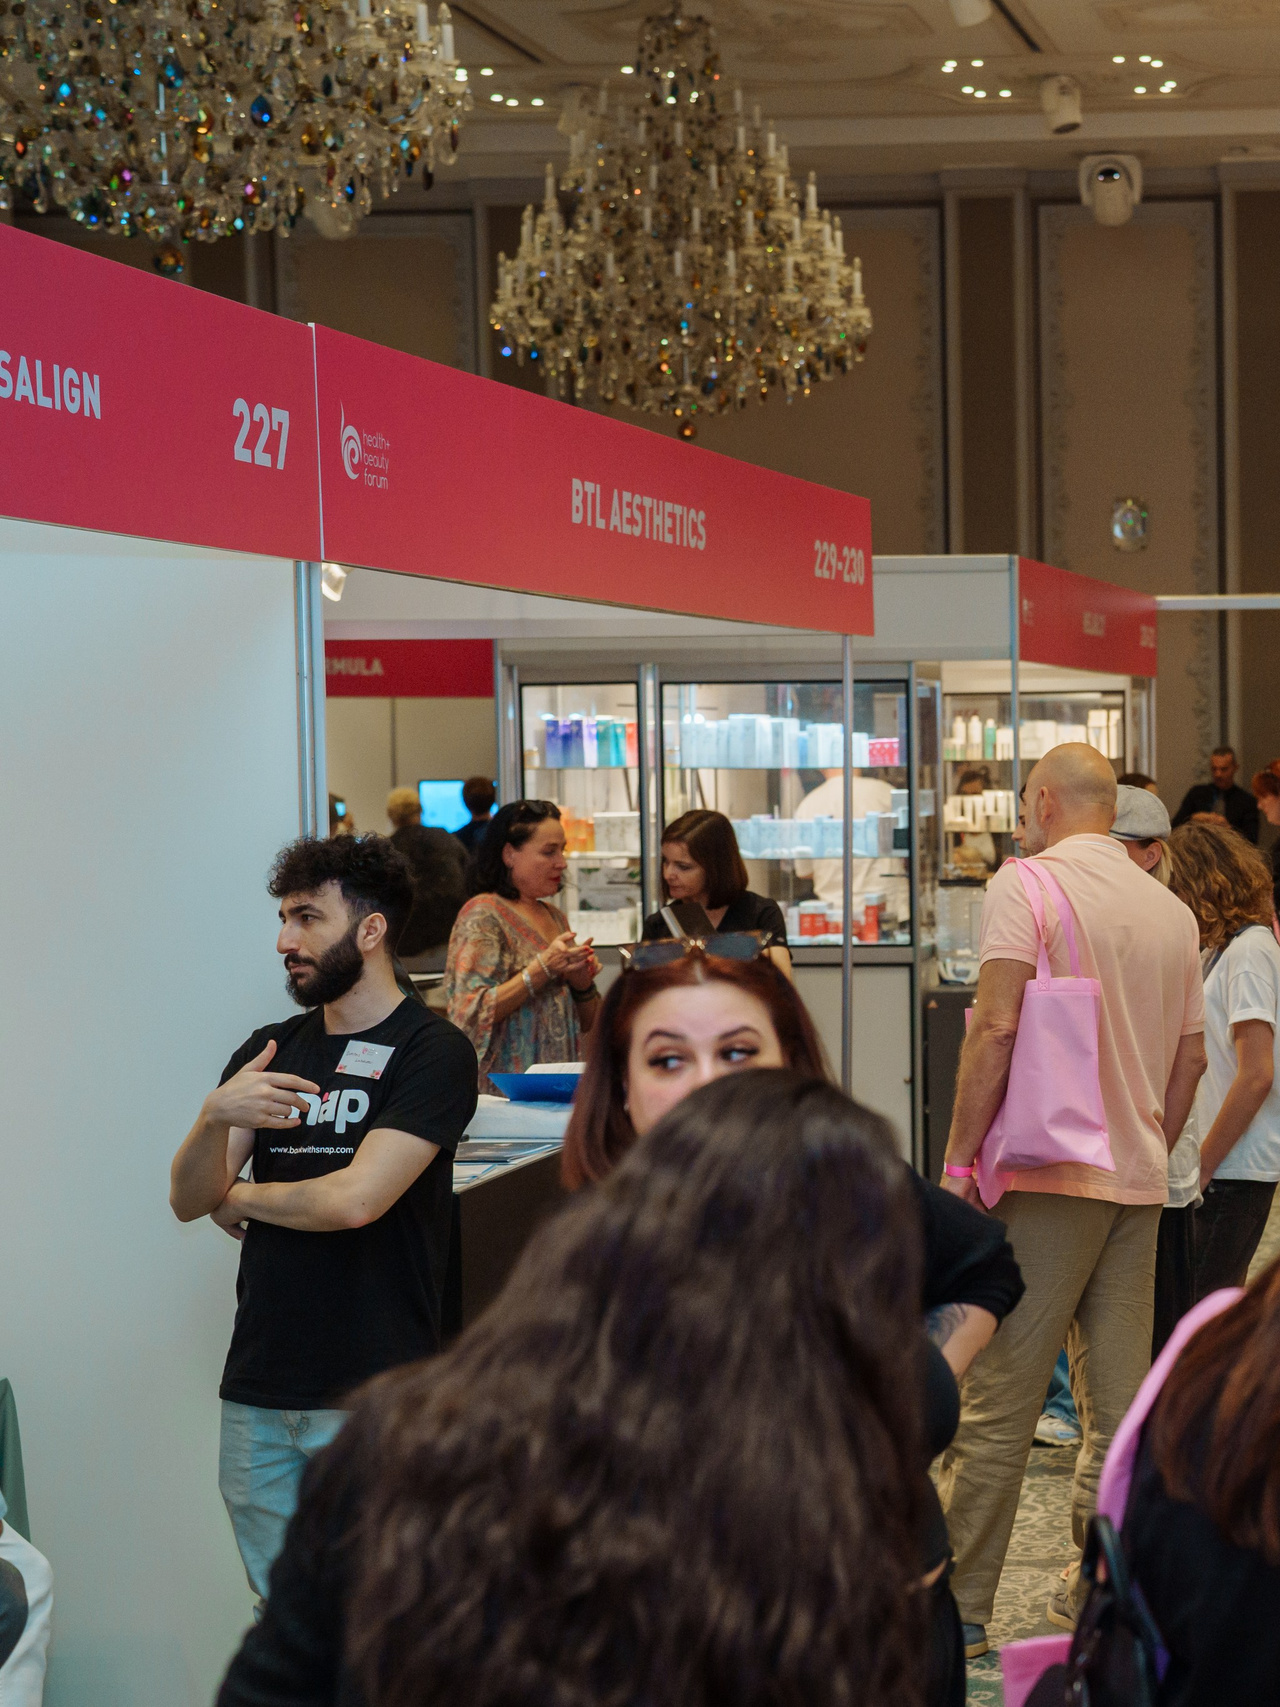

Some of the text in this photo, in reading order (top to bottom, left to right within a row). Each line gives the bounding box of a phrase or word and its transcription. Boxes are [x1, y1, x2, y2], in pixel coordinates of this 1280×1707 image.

[0, 350, 101, 419] SALIGN
[232, 397, 290, 470] 227
[362, 429, 390, 450] health+
[363, 449, 390, 474] beauty
[364, 468, 389, 490] forum
[571, 478, 706, 551] BTL AESTHETICS
[814, 540, 865, 585] 229-230
[288, 1089, 370, 1134] nap
